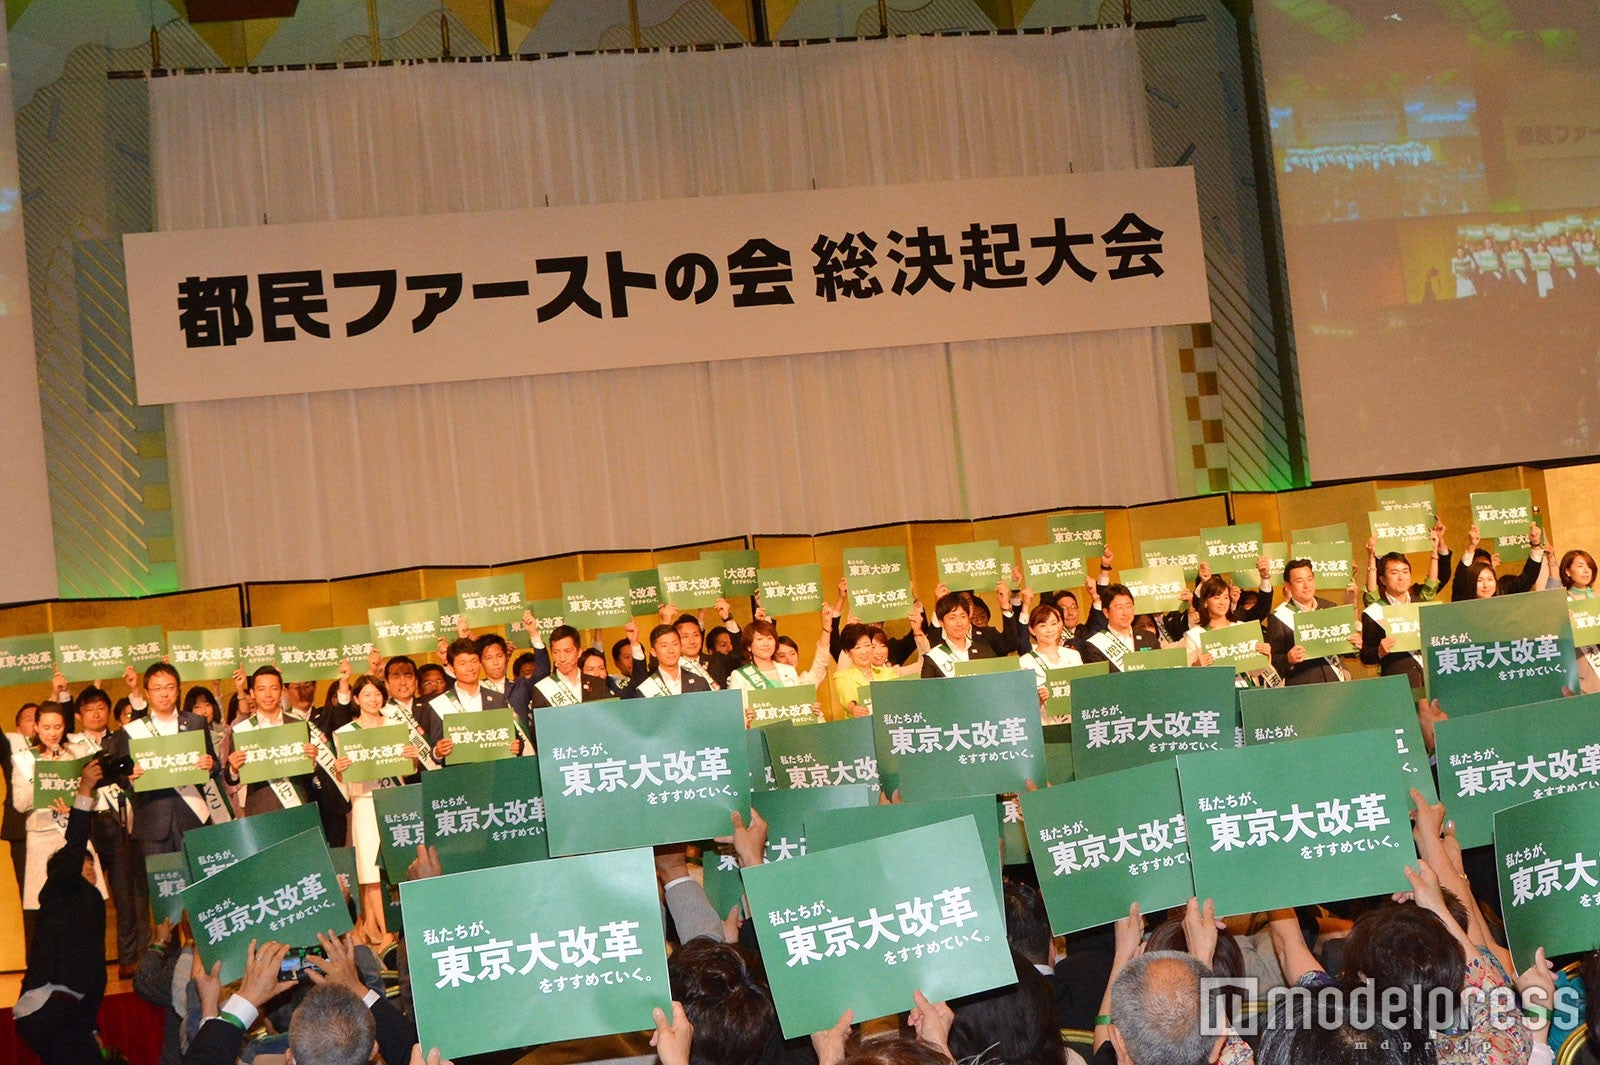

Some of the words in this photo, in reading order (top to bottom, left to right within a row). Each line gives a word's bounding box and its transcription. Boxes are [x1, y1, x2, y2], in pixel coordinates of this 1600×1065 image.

[177, 238, 795, 348] 都民ファーストの会
[811, 212, 1165, 303] 総決起大会
[1478, 507, 1528, 522] 東京大改革
[1054, 530, 1102, 544] 東京大改革
[1376, 524, 1426, 538] 東京大改革
[1208, 540, 1258, 556] 東京大改革
[850, 564, 901, 576] 東京大改革
[944, 558, 996, 574] 東京大改革
[1029, 558, 1082, 576] 東京大改革
[1147, 554, 1198, 568] 東京大改革
[666, 577, 721, 594] 東京大改革
[765, 582, 818, 598] 東京大改革
[1130, 582, 1181, 598] 東京大改革
[464, 592, 521, 610] 東京大改革
[570, 596, 626, 612] 東京大改革
[854, 588, 908, 607] 東京大改革
[376, 621, 436, 638] 東京大改革
[1300, 624, 1351, 641] 東京大改革
[1431, 632, 1472, 646] 私たちが、
[62, 646, 123, 663] 東京大改革
[174, 647, 234, 662] 東京大改革
[240, 644, 275, 658] 大改革
[281, 648, 338, 663] 東京大改革
[1435, 634, 1561, 674] 東京大改革
[1499, 664, 1567, 680] をすすめていく。
[755, 704, 812, 720] 東京大改革
[884, 712, 927, 725] 私たちが、
[1081, 704, 1123, 720] 私たちが、
[450, 728, 510, 744] 東京大改革
[888, 716, 1028, 755] 東京大改革
[1085, 710, 1220, 749] 東京大改革
[1254, 725, 1298, 740] 私たちが、
[245, 742, 304, 762] 東京大改革
[346, 743, 406, 763] 東京大改革
[552, 742, 608, 760] 私たちが、
[780, 752, 816, 765] 私たちが、
[958, 748, 1034, 764] をすすめていく。
[1450, 748, 1500, 766] 私たちが、
[138, 751, 200, 771] 東京大改革
[1456, 743, 1600, 797] 東京大改革
[560, 747, 732, 796] 東京大改革
[786, 756, 880, 789] 東京大改
[432, 795, 468, 810] 私たちが、
[646, 784, 738, 805] をすすめていく。
[1198, 792, 1258, 812] 私たちが、
[384, 812, 422, 824] 私たちが、
[1206, 793, 1390, 852] 東京大改革
[1040, 820, 1089, 842] 私たちが、
[1300, 835, 1400, 860] をすすめていく。
[1506, 843, 1546, 868] 私たちが、
[198, 849, 235, 865] 私たちが、
[1510, 852, 1598, 907] 東京大
[198, 897, 235, 922] 私たちが、
[204, 872, 327, 945] 東京大改革
[270, 900, 336, 931] をすすめていく。
[768, 900, 832, 926] 私たちが、
[422, 920, 490, 945] 私たちが、
[779, 886, 978, 968] 東京大改革
[432, 920, 642, 989] 東京大改革
[884, 930, 990, 966] をすすめていく。
[538, 967, 651, 994] をすすめていく。
